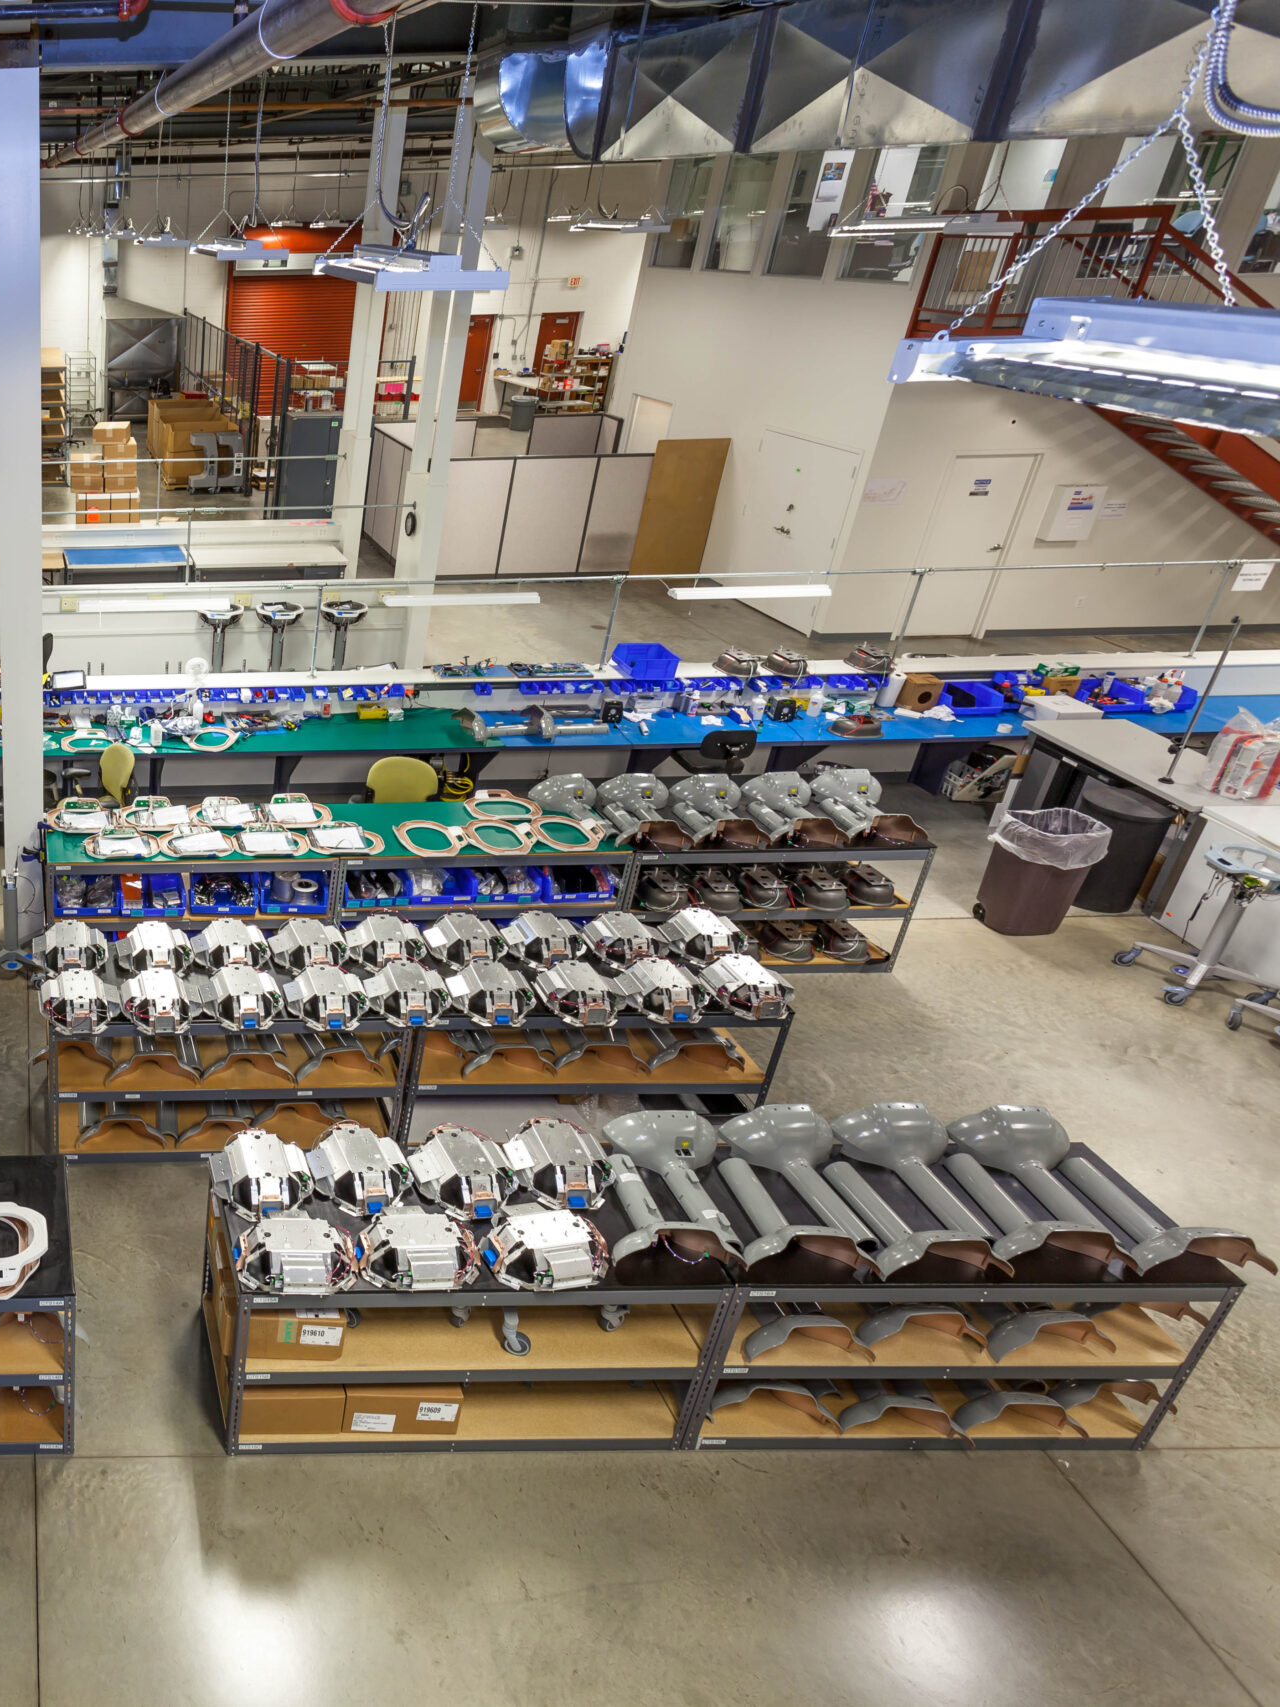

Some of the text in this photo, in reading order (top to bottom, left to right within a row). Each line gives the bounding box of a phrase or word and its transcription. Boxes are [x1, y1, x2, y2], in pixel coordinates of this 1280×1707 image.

[570, 277, 581, 286] EXIT
[302, 1329, 325, 1337] 919610
[419, 1406, 441, 1414] 919609
